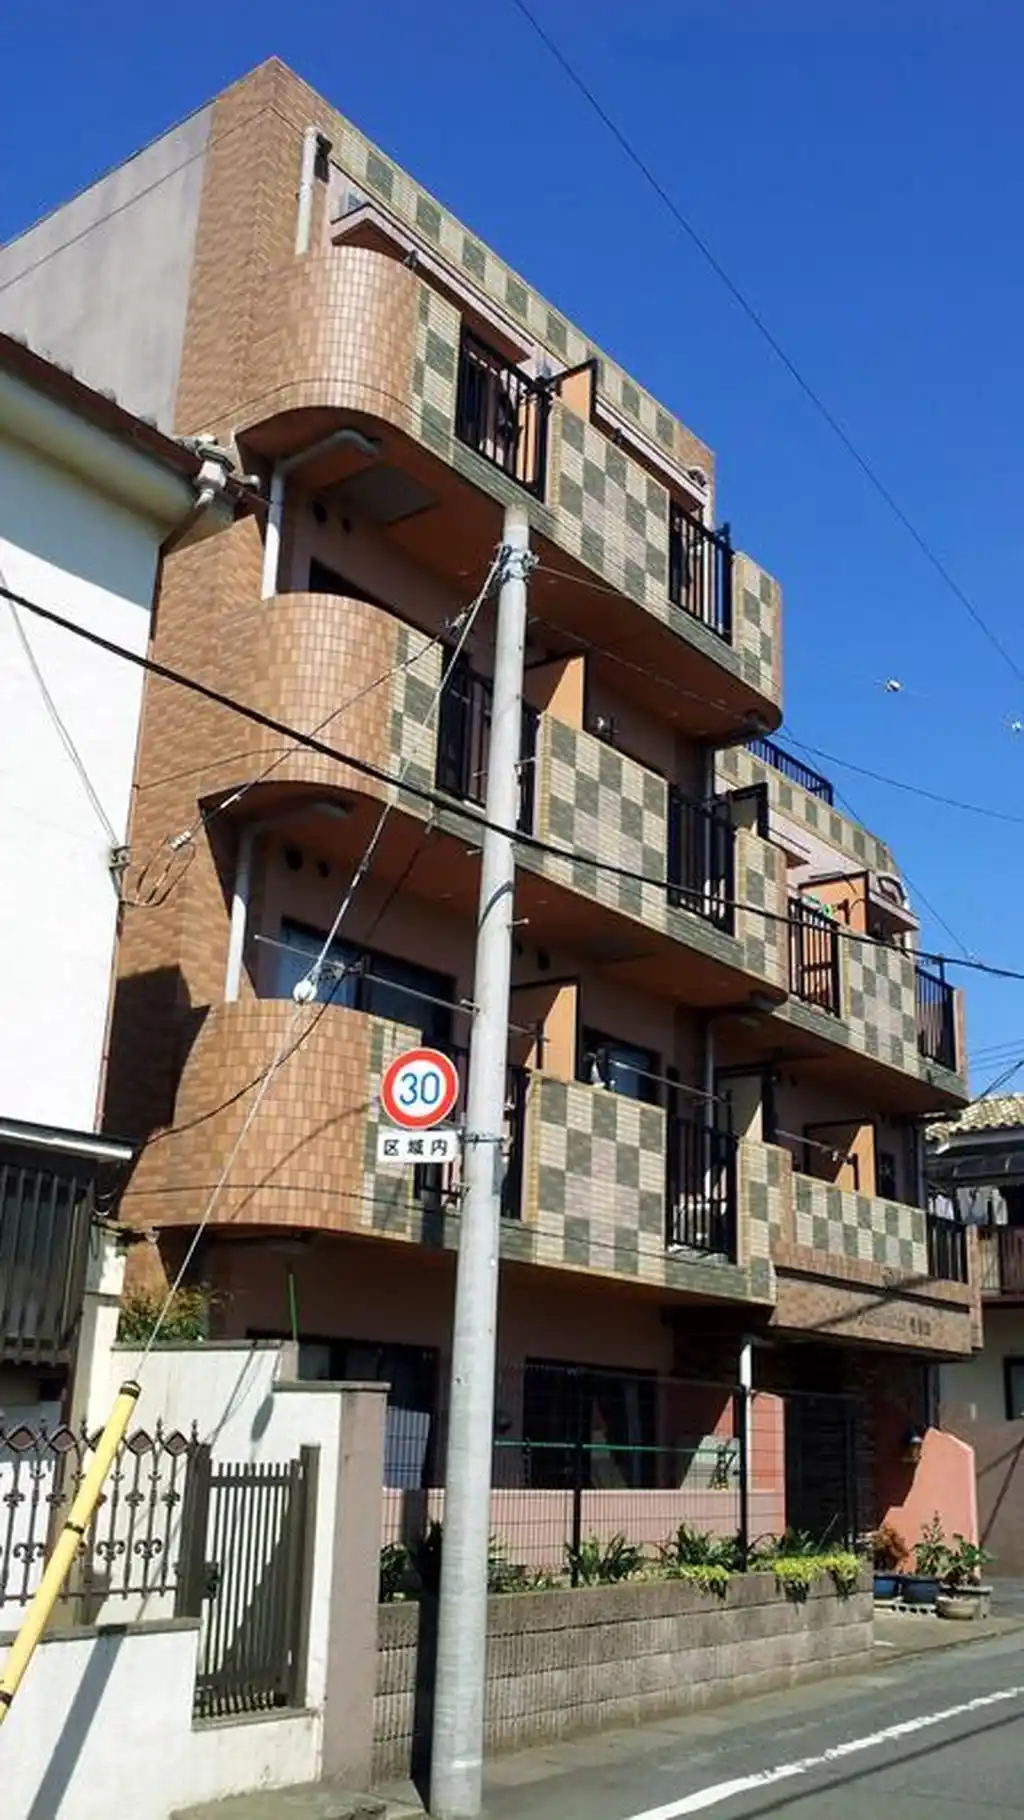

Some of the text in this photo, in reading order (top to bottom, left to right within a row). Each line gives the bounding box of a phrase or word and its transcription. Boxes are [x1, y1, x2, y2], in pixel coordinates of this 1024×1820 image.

[399, 1071, 440, 1105] 30
[383, 1139, 448, 1156] 区域内
